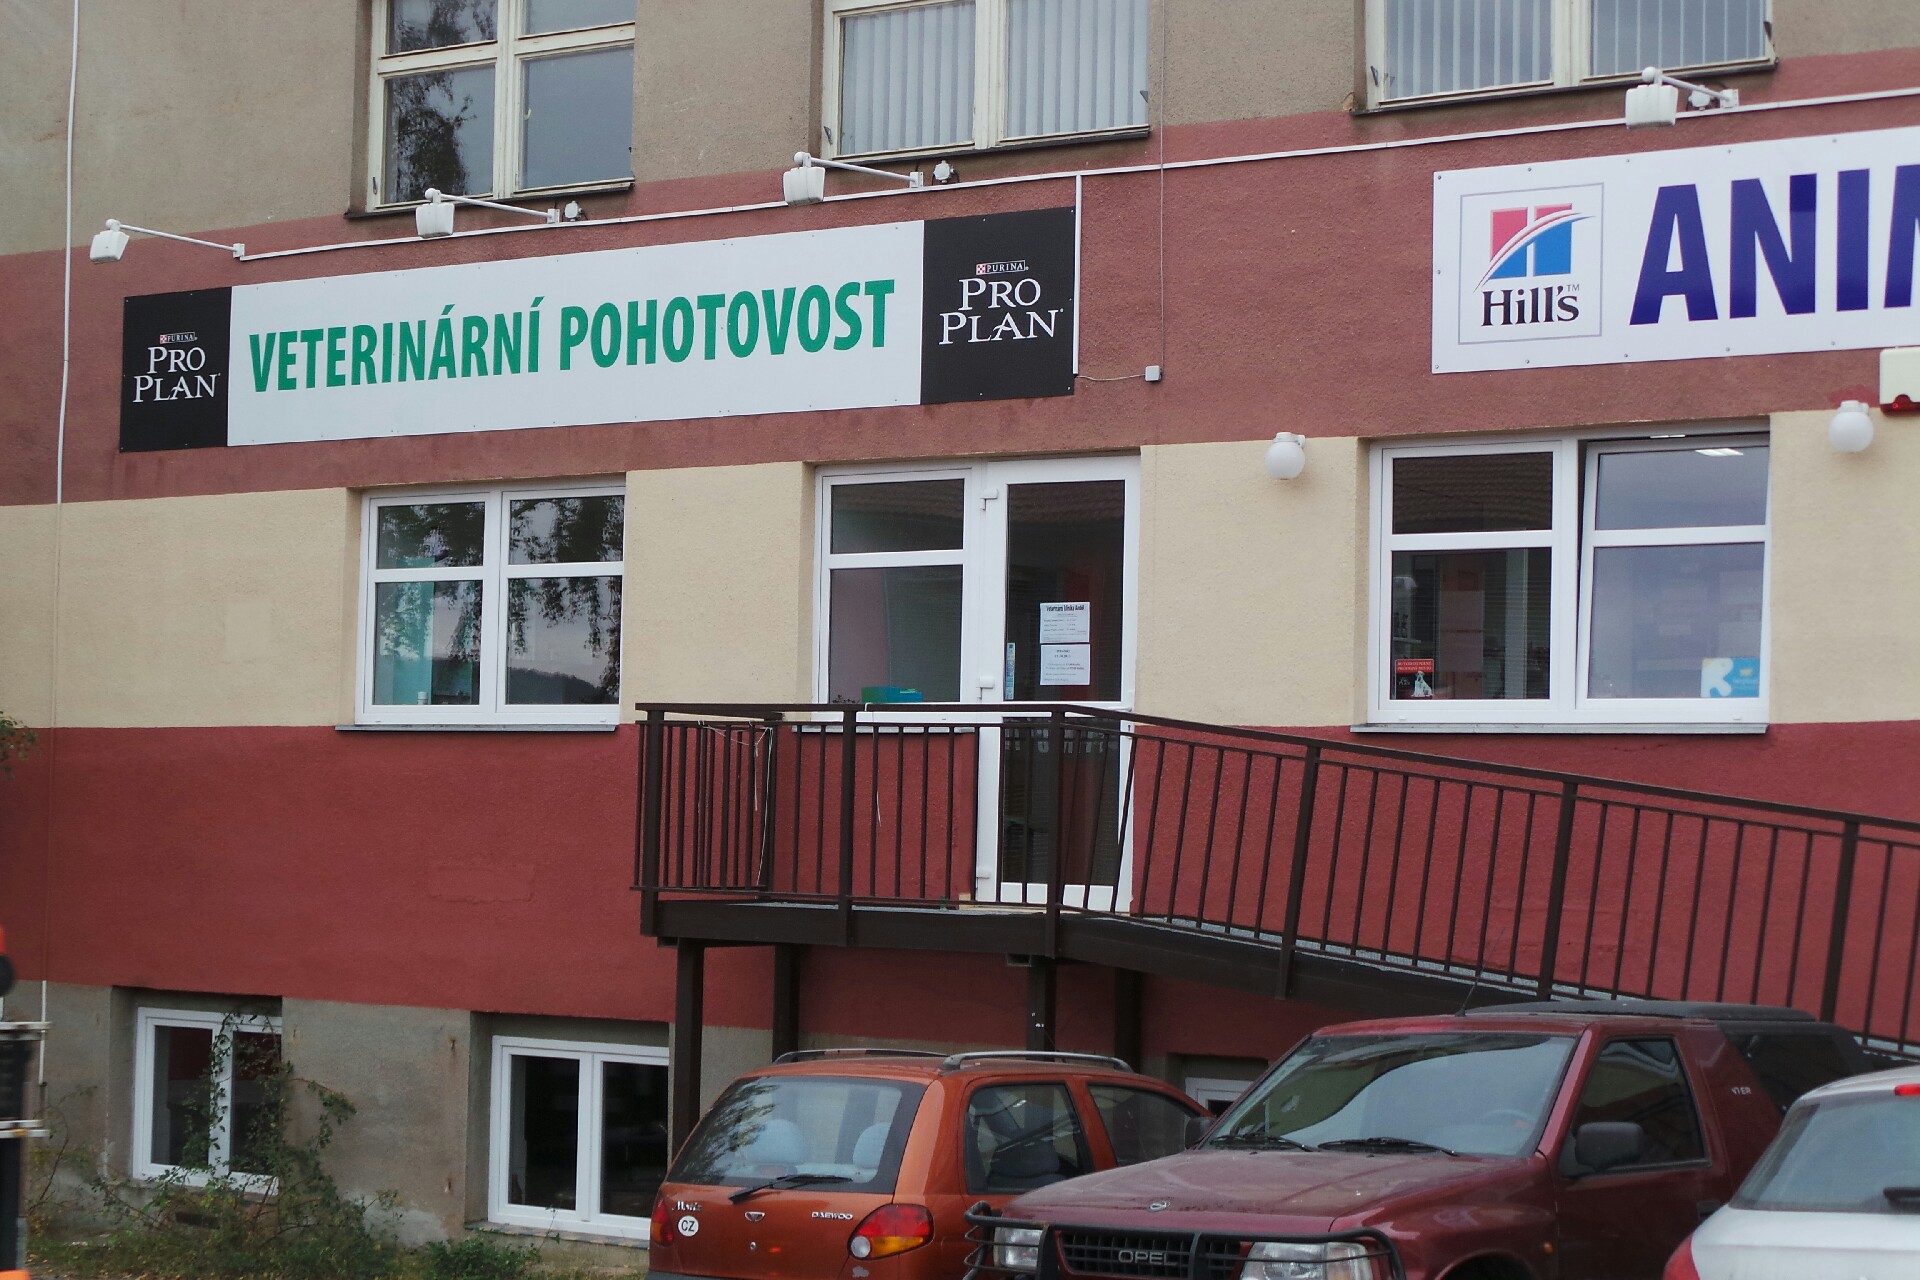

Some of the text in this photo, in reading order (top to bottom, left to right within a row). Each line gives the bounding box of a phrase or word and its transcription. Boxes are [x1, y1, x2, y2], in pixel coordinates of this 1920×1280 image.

[986, 261, 1024, 272] PURINA
[958, 278, 1041, 311] PRO
[1481, 285, 1579, 326] Hill's
[167, 332, 194, 342] PURINA
[249, 279, 895, 392] VETERINÁRNÍ POHOTOVOST
[939, 310, 1059, 345] PLAN
[146, 346, 205, 374] PRO
[132, 374, 218, 403] PLAN
[681, 1220, 695, 1232] CZ
[811, 1211, 853, 1220] DAEWOO
[1118, 1250, 1178, 1266] OPEL
